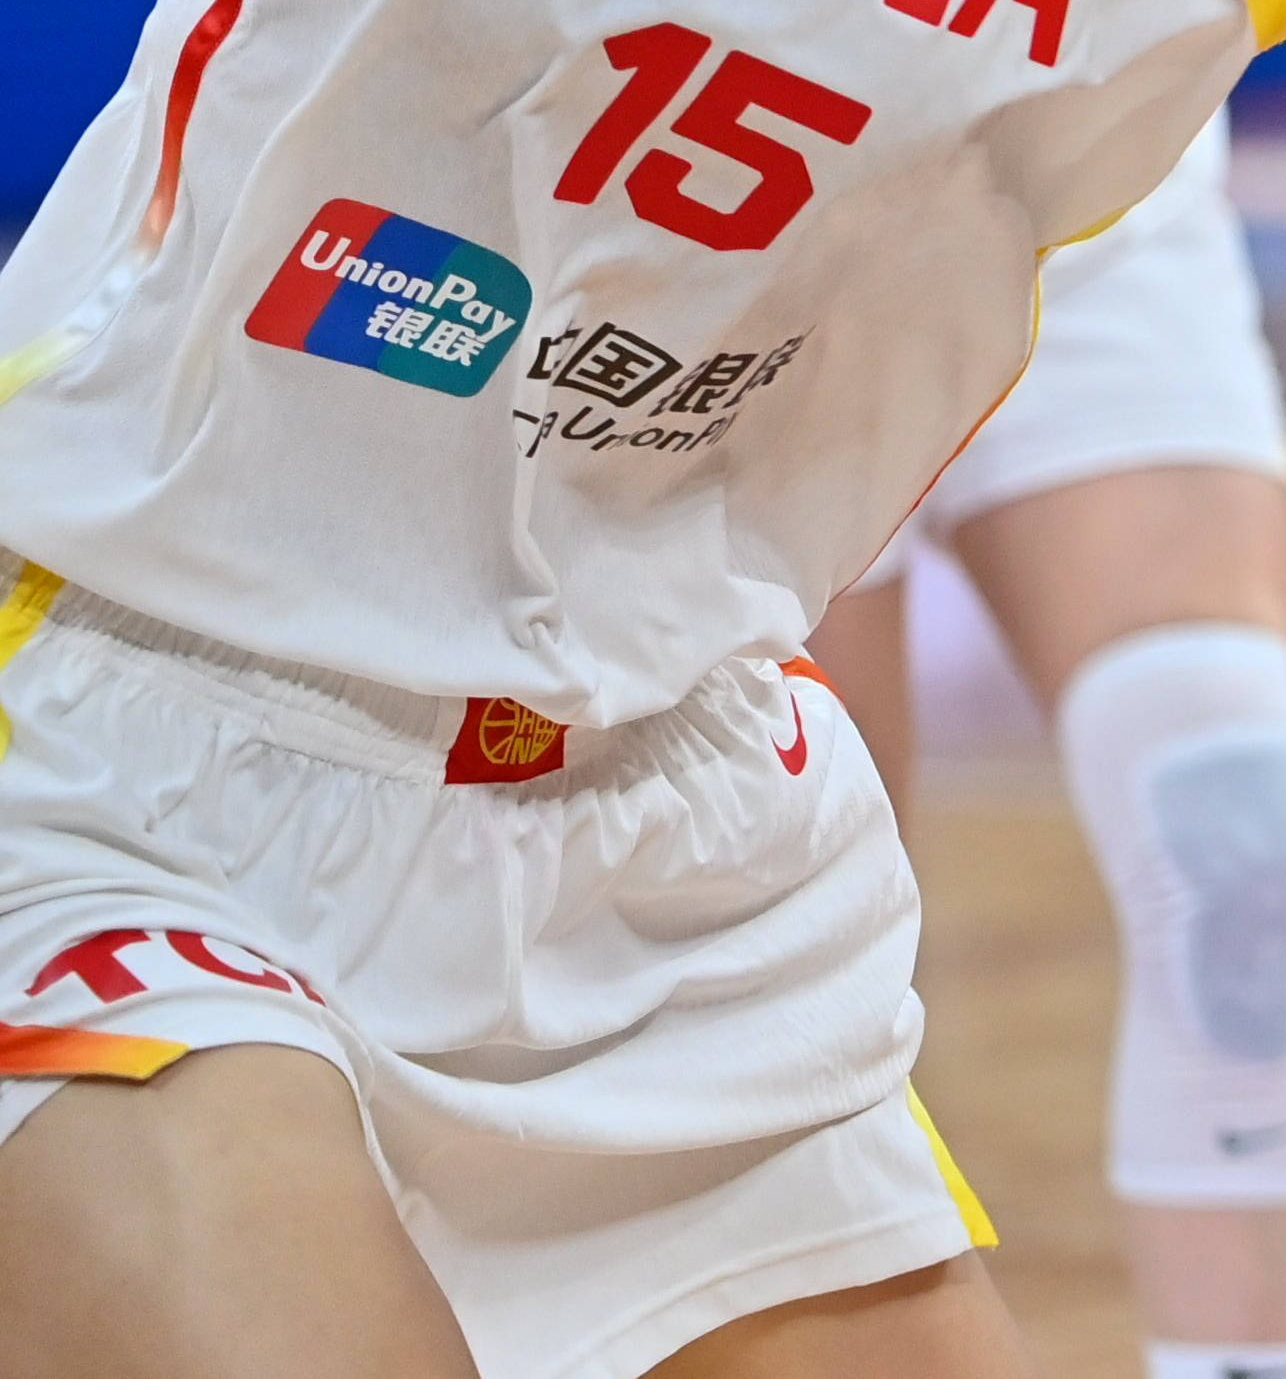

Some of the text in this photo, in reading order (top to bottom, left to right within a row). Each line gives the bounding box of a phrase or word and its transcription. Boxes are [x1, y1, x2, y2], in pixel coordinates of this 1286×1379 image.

[553, 22, 872, 251] 15
[300, 229, 517, 343] UnionPay
[365, 301, 485, 366] 银联
